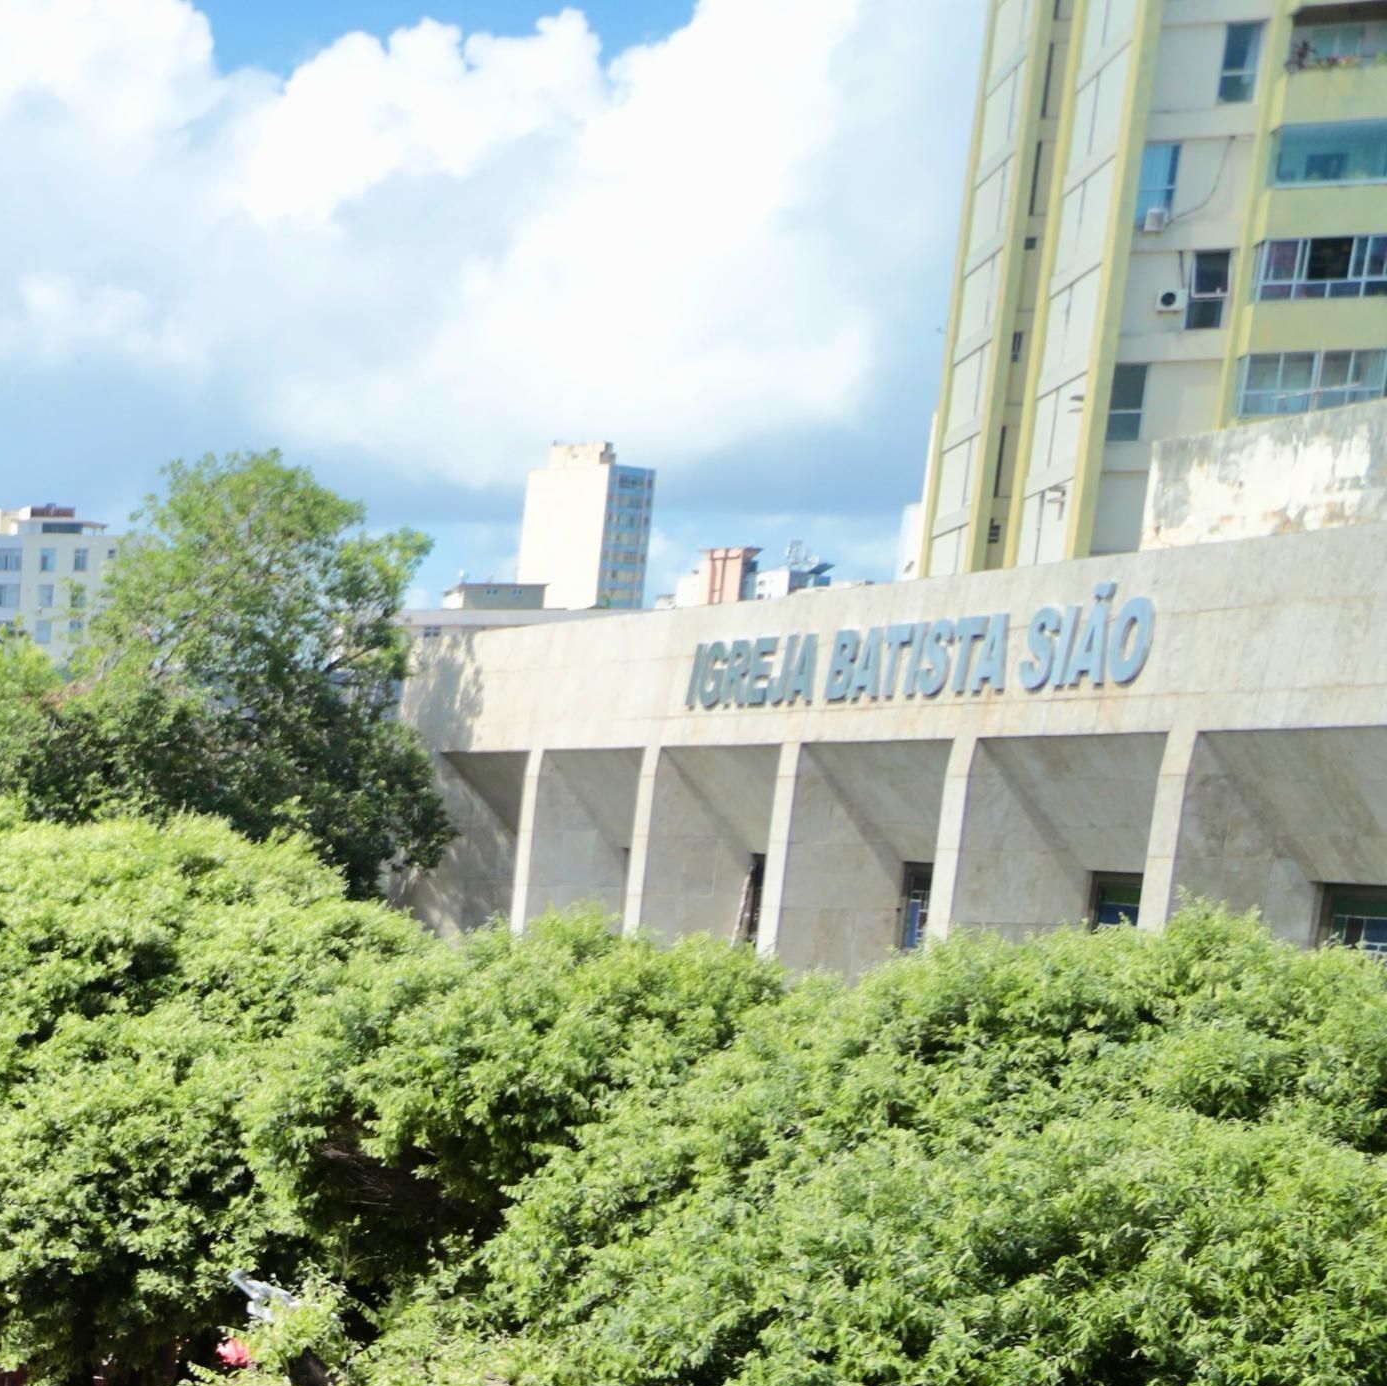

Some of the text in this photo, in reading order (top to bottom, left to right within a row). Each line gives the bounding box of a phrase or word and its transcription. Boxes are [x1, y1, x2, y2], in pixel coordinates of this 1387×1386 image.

[685, 582, 1156, 709] IGREJA BATISTA SIÃO
